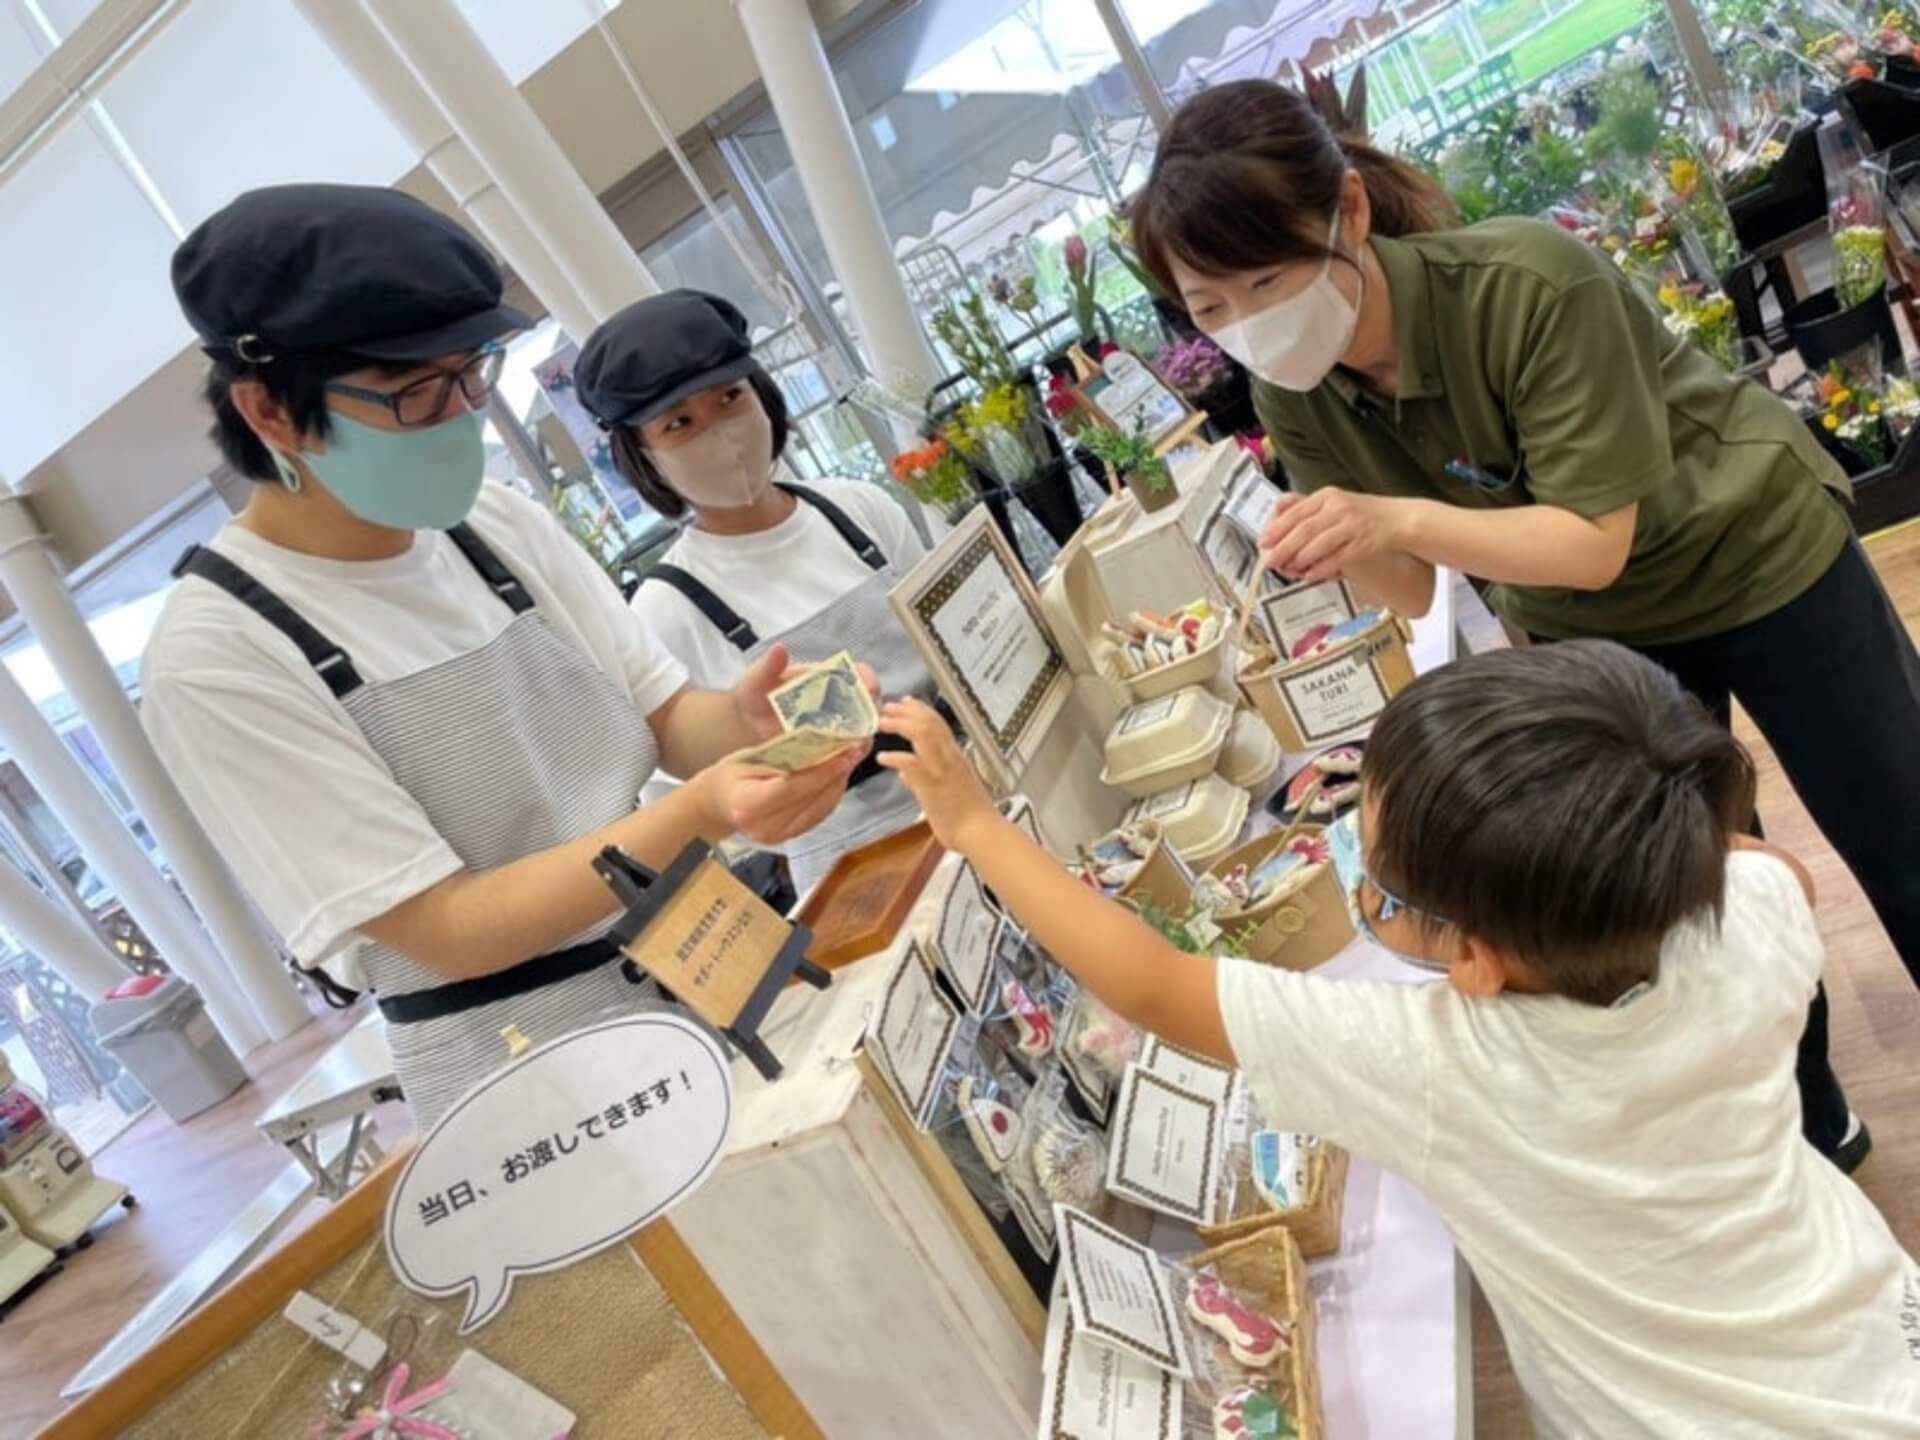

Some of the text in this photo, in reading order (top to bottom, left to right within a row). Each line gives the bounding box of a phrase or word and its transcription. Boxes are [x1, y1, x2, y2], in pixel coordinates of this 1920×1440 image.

[1300, 666, 1357, 695] SAKANA
[1320, 683, 1350, 702] TURI
[418, 1070, 694, 1226] 当日、お渡しできます！
